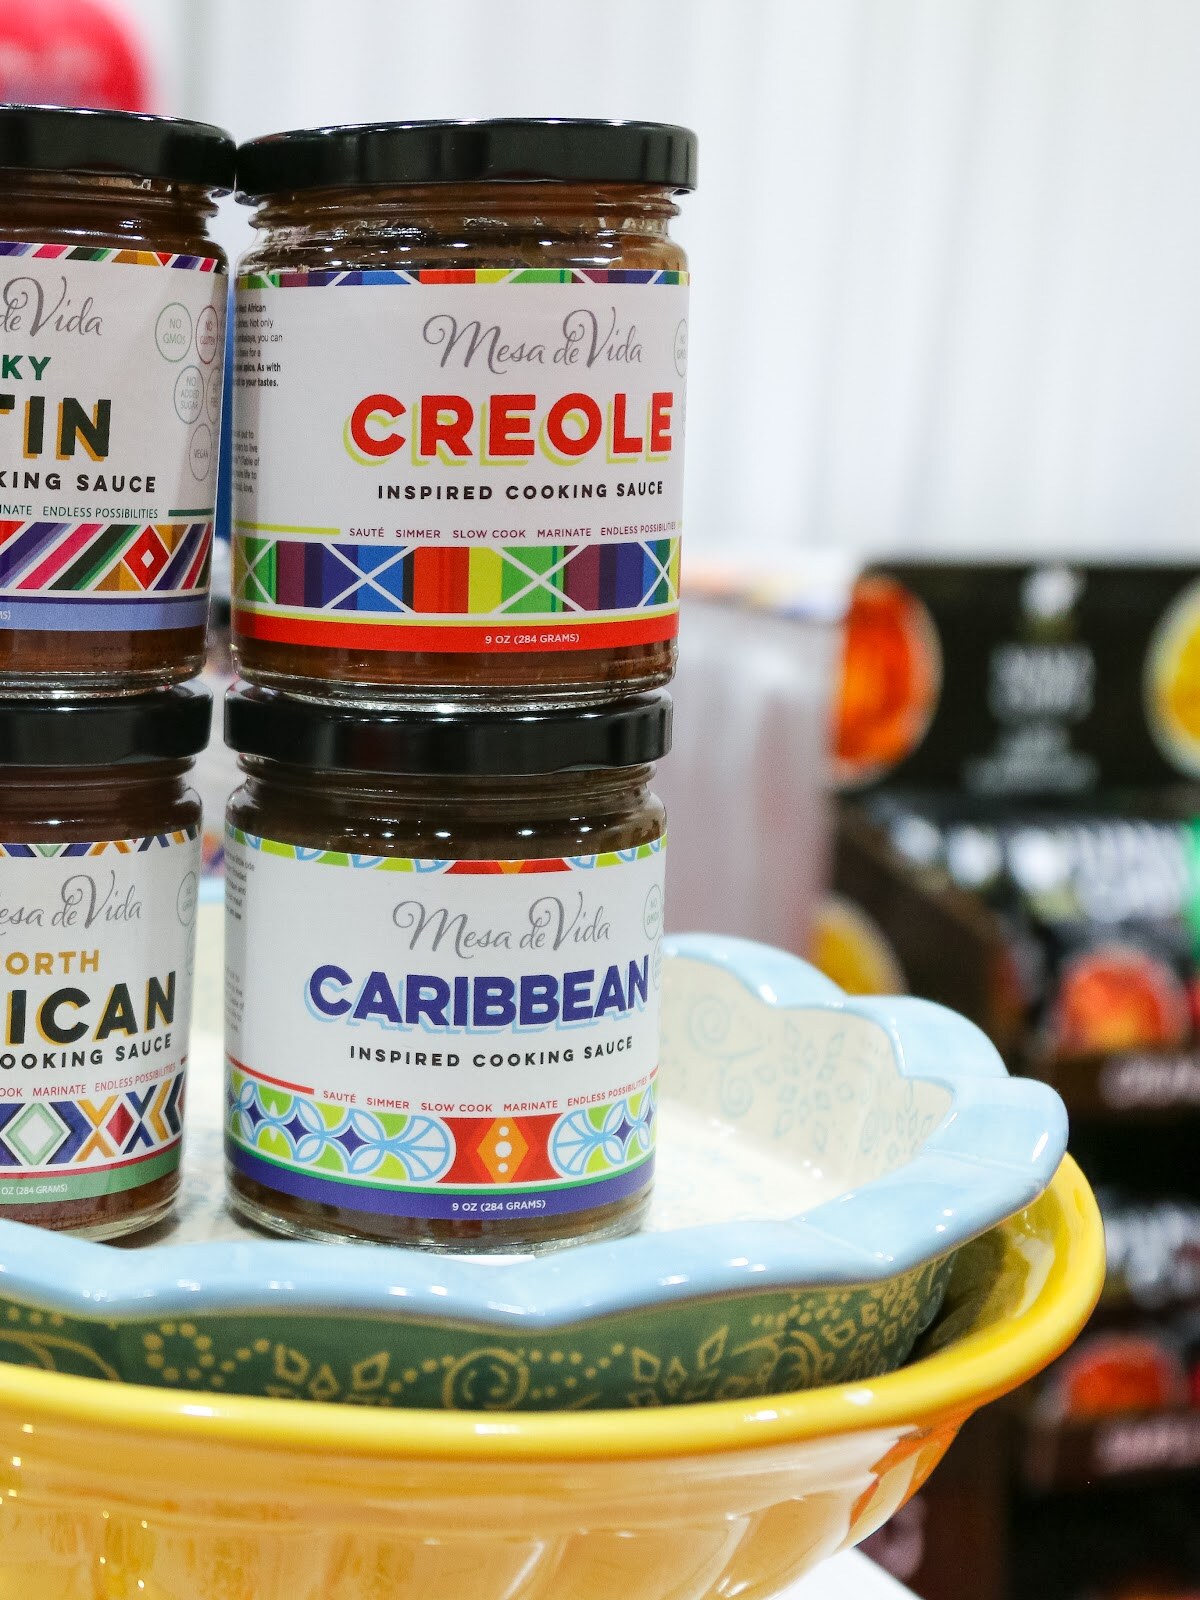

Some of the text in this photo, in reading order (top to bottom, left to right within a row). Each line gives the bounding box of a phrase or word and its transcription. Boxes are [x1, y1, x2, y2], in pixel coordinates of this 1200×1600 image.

[3, 275, 103, 337] Vida
[169, 318, 181, 329] NO
[260, 318, 273, 328] only
[271, 334, 282, 342] can
[562, 306, 643, 368] Vida
[163, 333, 186, 344] GMOs
[422, 314, 544, 374] Mesa
[553, 329, 578, 365] de
[186, 376, 196, 386] NO
[257, 363, 264, 371] As
[266, 363, 281, 372] with
[258, 378, 278, 386] tastes.
[343, 392, 674, 467] CREOLE
[76, 474, 156, 493] SAUCE
[378, 481, 663, 500] INSPIRED COOKING SAUCE
[43, 506, 92, 517] ENDLESS
[95, 507, 158, 519] POSSIBILITIES
[350, 522, 676, 538] SAUTÉ SIMMER SLOW COOK MARINATE ENDLESS POSSIBILITIES
[485, 634, 579, 644] 9 OZ (284 GRAMS)
[51, 895, 76, 927] de
[61, 870, 142, 929] Vida
[392, 900, 512, 960] Mesa
[519, 919, 546, 951] de
[528, 892, 610, 951] Vida
[304, 954, 649, 1034] CARIBBEAN
[115, 1032, 172, 1062] SAUCE
[350, 1036, 632, 1068] INSPIRED COOKING SAUCE
[32, 1084, 86, 1096] MARINATE
[95, 1077, 133, 1091] ENDLESS
[135, 1062, 176, 1084] POSSIBILITIES
[323, 1077, 647, 1112] SAUTÉ SIMMER SLOW COOK MARINATE ENDLESS POSSIBILITIES
[16, 1186, 33, 1195] (284
[36, 1184, 68, 1194] GRAMS)
[453, 1200, 546, 1212] 9 OZ (284 GRAMS)
